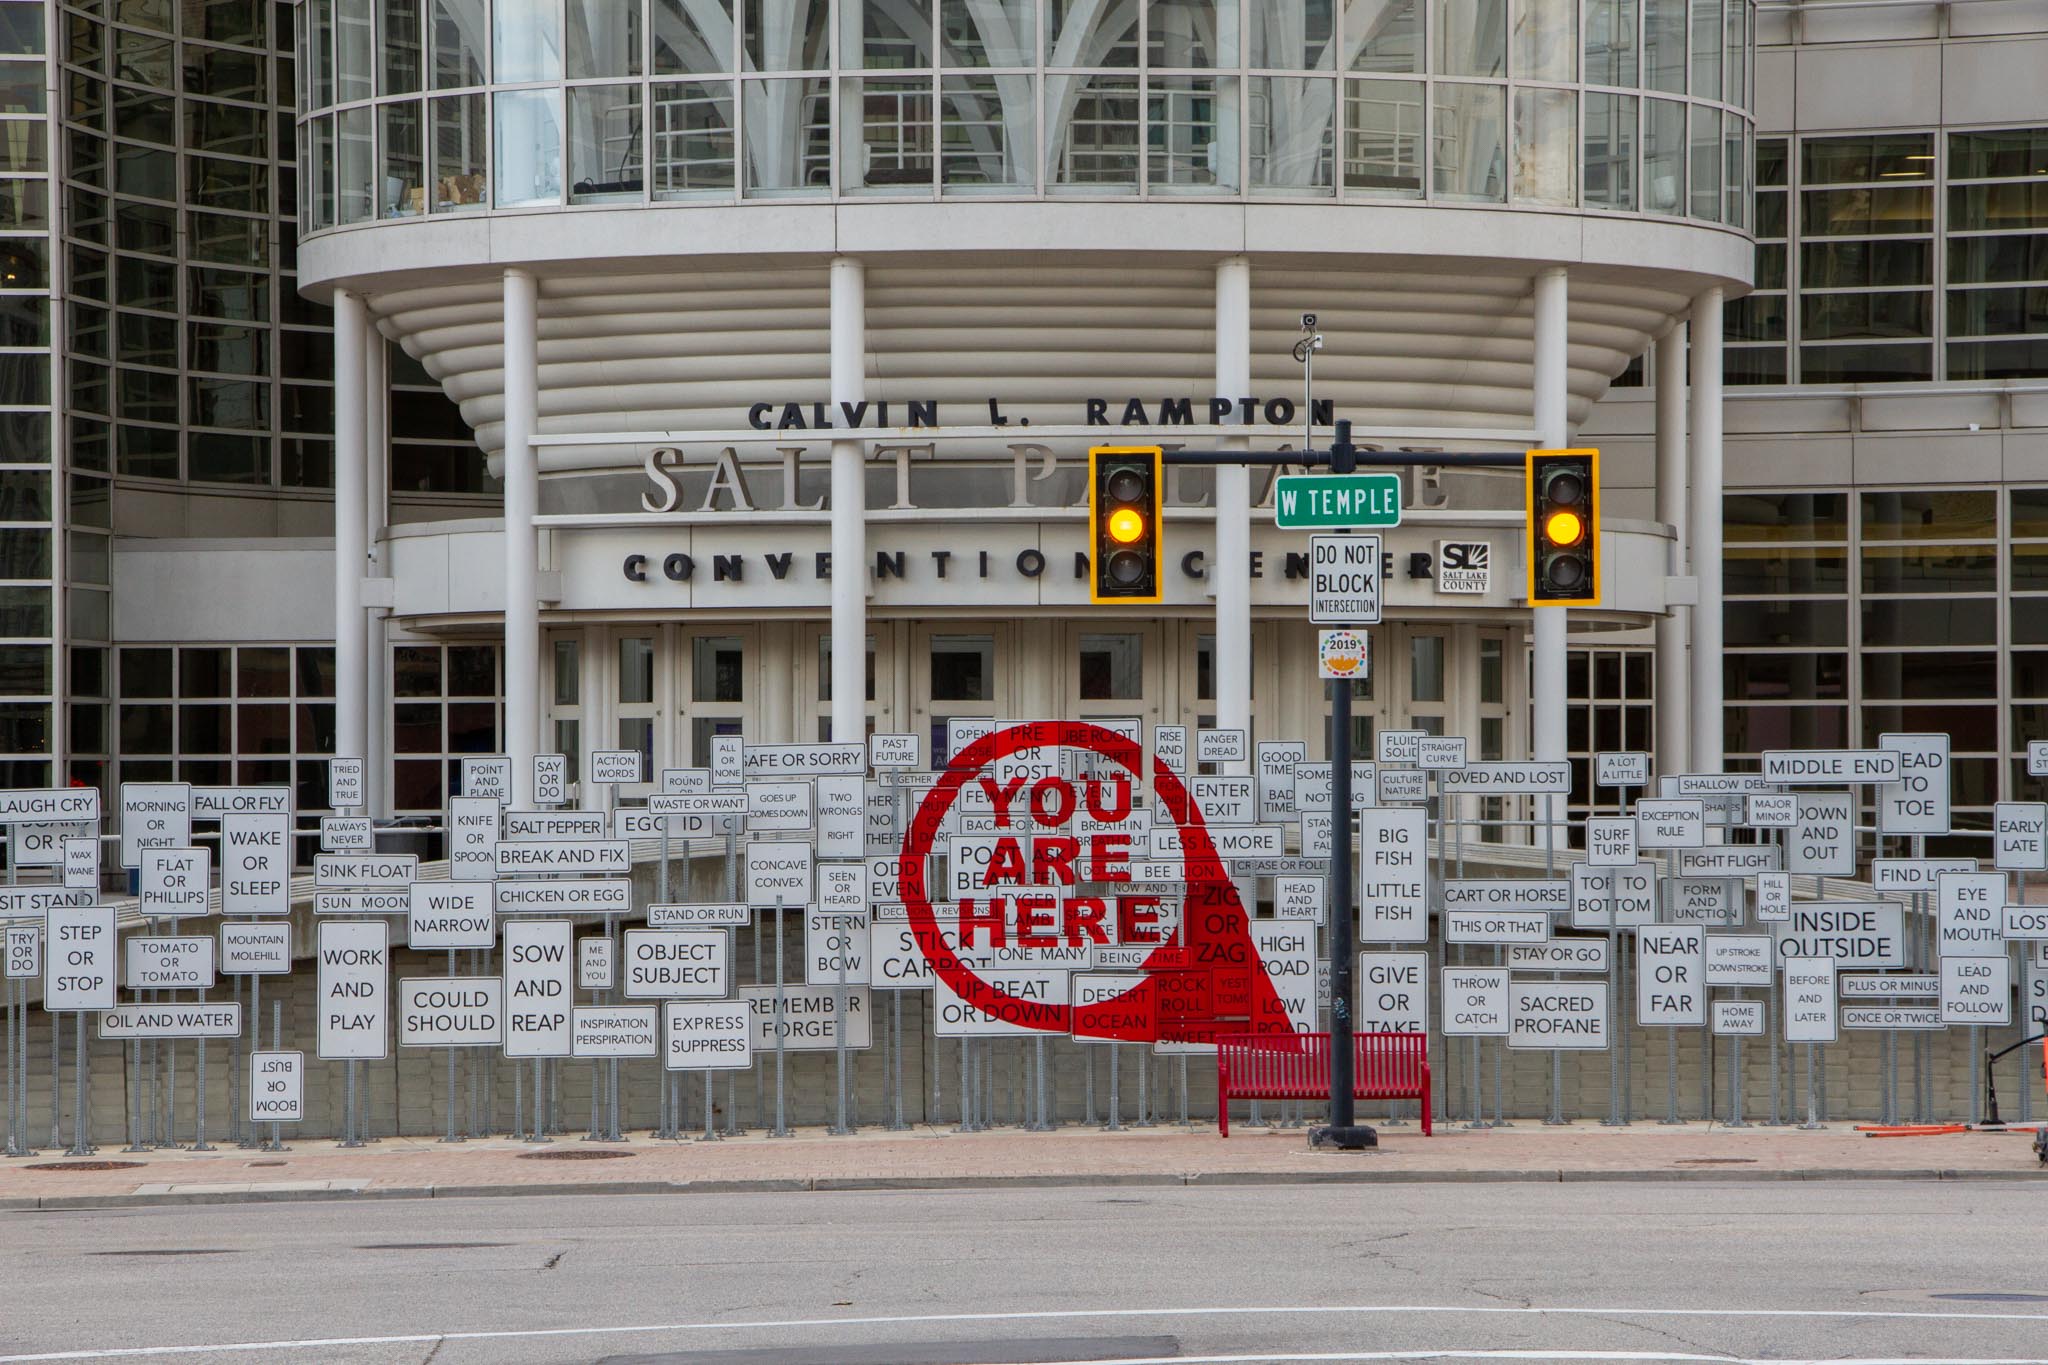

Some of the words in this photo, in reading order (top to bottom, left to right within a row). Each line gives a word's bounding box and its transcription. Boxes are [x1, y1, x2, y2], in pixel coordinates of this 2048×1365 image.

[749, 400, 938, 429] CALVIN
[1087, 398, 1334, 425] RAMPTON
[641, 442, 935, 513] SALT
[1282, 490, 1297, 516] W
[1309, 489, 1394, 515] TEMPLE
[1317, 545, 1336, 564] DO
[1345, 545, 1374, 564] NOT
[1443, 571, 1464, 581] SALT
[1464, 572, 1487, 581] LAKE
[1317, 574, 1373, 593] BLOCK
[1443, 580, 1487, 590] COUNTY
[1316, 600, 1374, 612] INTERSECTION
[1330, 640, 1357, 650] 2019
[1010, 727, 1044, 741] PRE
[1204, 734, 1237, 743] ANGER
[883, 739, 908, 748] PAST
[876, 752, 913, 761] FUTURE
[1012, 744, 1042, 760] OR
[597, 757, 635, 765] ACTION
[1769, 760, 1842, 774] MIDDLE
[1855, 759, 1894, 773] END
[598, 769, 634, 777] WORDS
[1004, 765, 1054, 781] POST
[1383, 776, 1423, 784] CULTURE
[1196, 784, 1249, 797] ENTER
[127, 802, 185, 812] MORNING
[654, 800, 690, 809] WASTE
[693, 800, 709, 808] OR
[711, 799, 744, 808] WANT
[978, 777, 1131, 827] YOU
[1755, 800, 1791, 808] MAJOR
[1205, 803, 1240, 816] EXIT
[1642, 811, 1699, 820] EXCEPTION
[1756, 813, 1790, 821] MINOR
[147, 820, 164, 830] OR
[327, 823, 366, 831] ALWAYS
[510, 821, 544, 834] SALT
[548, 821, 600, 833] PEPPER
[1657, 826, 1684, 836] RULE
[2000, 821, 2043, 832] EARLY
[230, 832, 280, 845] WAKE
[331, 835, 363, 844] NEVER
[1380, 829, 1408, 843] BIG
[1594, 829, 1629, 840] SURF
[1159, 836, 1198, 851] LESS
[1202, 835, 1216, 850] IS
[1224, 836, 1273, 849] MORE
[1594, 844, 1630, 855] TURF
[2004, 840, 2038, 851] LATE
[243, 856, 268, 870] OR
[983, 834, 1131, 885] ARE
[1376, 851, 1411, 865] FISH
[157, 859, 193, 871] FLAT
[321, 865, 357, 877] SINK
[362, 865, 412, 877] FLOAT
[751, 860, 807, 870] CONCAVE
[1145, 866, 1170, 877] BEE
[1180, 865, 1216, 878] LION
[164, 875, 185, 887] OR
[755, 878, 803, 887] CONVEX
[829, 873, 855, 881] SEEN
[231, 881, 280, 895] SLEEP
[835, 884, 850, 892] OR
[1285, 884, 1315, 893] HEAD
[1368, 884, 1420, 897] LITTLE
[1958, 888, 1987, 900] EYE
[145, 891, 204, 903] PHILLIPS
[429, 897, 473, 909] WIDE
[825, 896, 860, 904] HEARD
[1203, 887, 1241, 906] ZIG
[1287, 896, 1312, 904] AND
[1444, 889, 1485, 904] CART
[1489, 889, 1510, 902] OR
[1516, 889, 1566, 901] HORSE
[1282, 907, 1318, 916] HEART
[1376, 906, 1411, 920] FISH
[1954, 908, 1990, 920] AND
[415, 919, 489, 932] NARROW
[958, 897, 1160, 948] HERE
[1205, 914, 1239, 934] OR
[1452, 920, 1481, 932] THIS
[1485, 921, 1505, 932] OR
[1508, 921, 1544, 933] THAT
[1795, 912, 1876, 931] INSIDE
[60, 926, 101, 940] STEP
[1944, 928, 2001, 941] MOUTH
[228, 936, 283, 944] MOUNTAIN
[1644, 937, 1698, 954] NEAR
[513, 944, 565, 964] SOW
[590, 946, 603, 954] ME
[637, 944, 716, 960] OBJECT
[1197, 944, 1245, 962] ZAG
[1513, 947, 1548, 960] STAY
[1551, 948, 1572, 960] OR
[1576, 948, 1601, 961] GO
[1780, 938, 1891, 959] OUTSIDE
[68, 951, 93, 965] OR
[231, 952, 280, 960] MOLEHILL
[324, 950, 382, 965] WORK
[1100, 953, 1141, 963] BEING
[1151, 952, 1183, 963] TIME
[586, 959, 606, 967] AND
[633, 967, 720, 983] SUBJECT
[1370, 967, 1418, 984] GIVE
[1656, 966, 1687, 983] OR
[1958, 967, 1991, 977] LEAD
[58, 977, 103, 991] STOP
[1452, 978, 1500, 988] THROW
[1790, 976, 1829, 984] BEFORE
[331, 982, 373, 997] AND
[514, 978, 562, 998] AND
[1960, 984, 1989, 995] AND
[414, 992, 488, 1008] COULD
[1083, 989, 1148, 1002] DESERT
[1467, 996, 1485, 1006] OR
[1798, 994, 1822, 1003] AND
[1379, 994, 1409, 1011] OR
[1521, 997, 1593, 1011] SACRED
[1652, 995, 1692, 1012] FAR
[1947, 1002, 2003, 1013] FOLLOW
[1455, 1013, 1497, 1024] CATCH
[1722, 1008, 1754, 1016] HOME
[1795, 1013, 1826, 1021] LATER
[106, 1015, 133, 1028] OIL
[137, 1015, 173, 1027] AND
[177, 1014, 232, 1026] WATER
[331, 1015, 375, 1029] PLAY
[408, 1015, 494, 1031] SHOULD
[513, 1013, 565, 1033] REAP
[581, 1019, 648, 1028] INSPIRATION
[674, 1017, 743, 1030] EXPRESS
[1082, 1014, 1147, 1028] OCEAN
[1515, 1019, 1600, 1033] PROFANE
[577, 1035, 652, 1044] PERSPIRATION
[672, 1039, 745, 1052] SUPPRESS
[268, 1081, 286, 1092] OR
